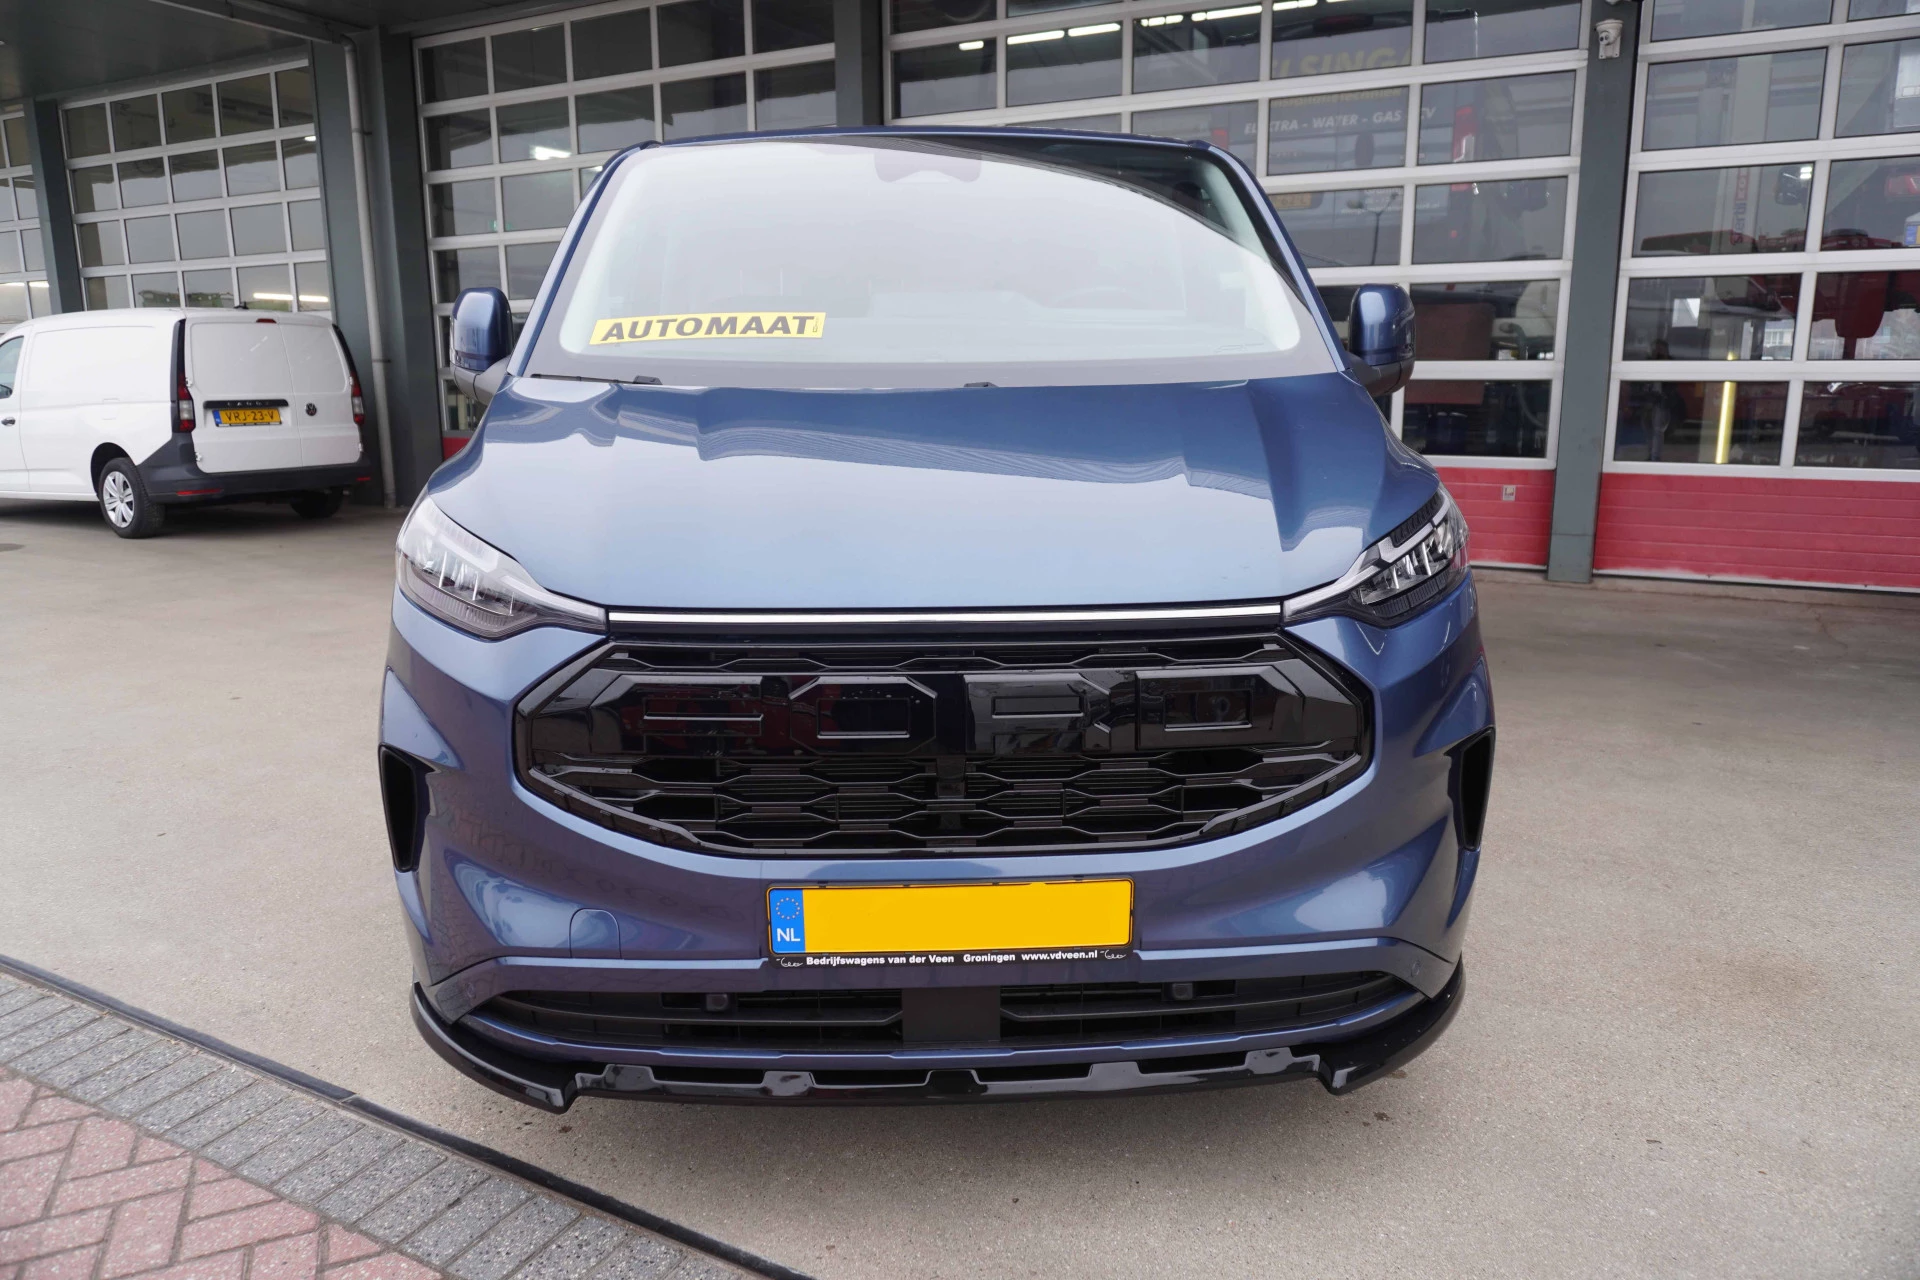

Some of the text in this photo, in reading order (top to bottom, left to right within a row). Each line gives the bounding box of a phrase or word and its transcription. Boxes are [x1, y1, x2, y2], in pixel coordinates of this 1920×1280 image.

[1272, 46, 1411, 78] LSING
[1244, 119, 1299, 135] ELTRA
[1312, 113, 1358, 129] WATER
[1372, 110, 1403, 124] GAS
[600, 315, 814, 341] AUTOMAAT
[776, 927, 801, 942] NL
[806, 955, 885, 967] Bedrijfswagens
[887, 956, 906, 964] van
[908, 954, 926, 964] der
[928, 954, 954, 963] Veen
[963, 953, 1016, 963] Groningen
[1021, 949, 1098, 960] www.vdveen.nl
